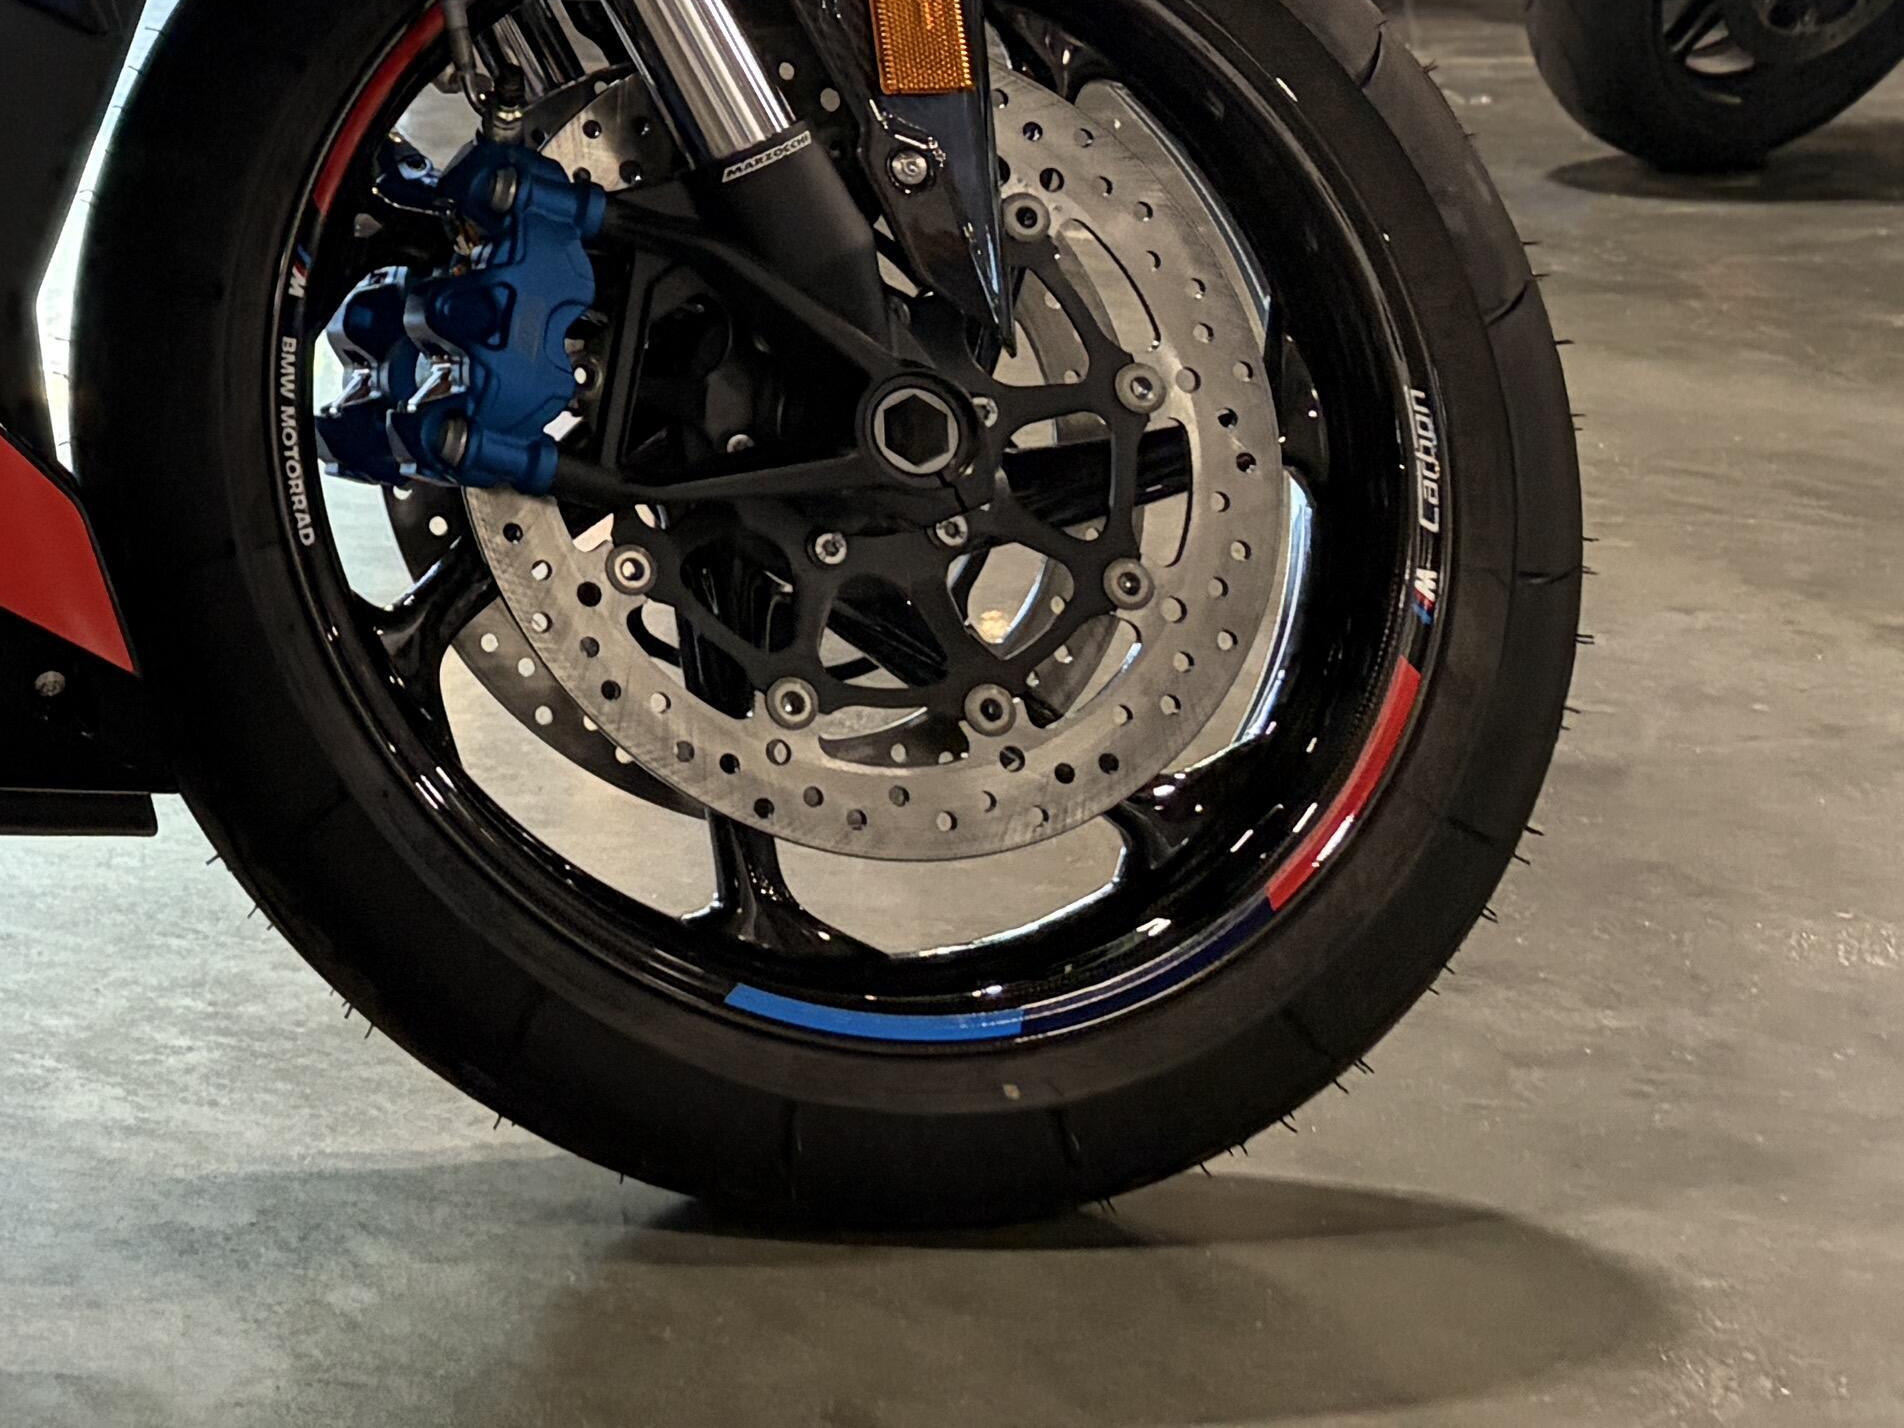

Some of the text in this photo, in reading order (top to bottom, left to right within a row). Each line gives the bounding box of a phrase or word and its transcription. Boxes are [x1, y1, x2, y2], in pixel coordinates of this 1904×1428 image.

[726, 134, 809, 177] MARZOCCHI
[280, 336, 315, 546] BMW MOTORRAD
